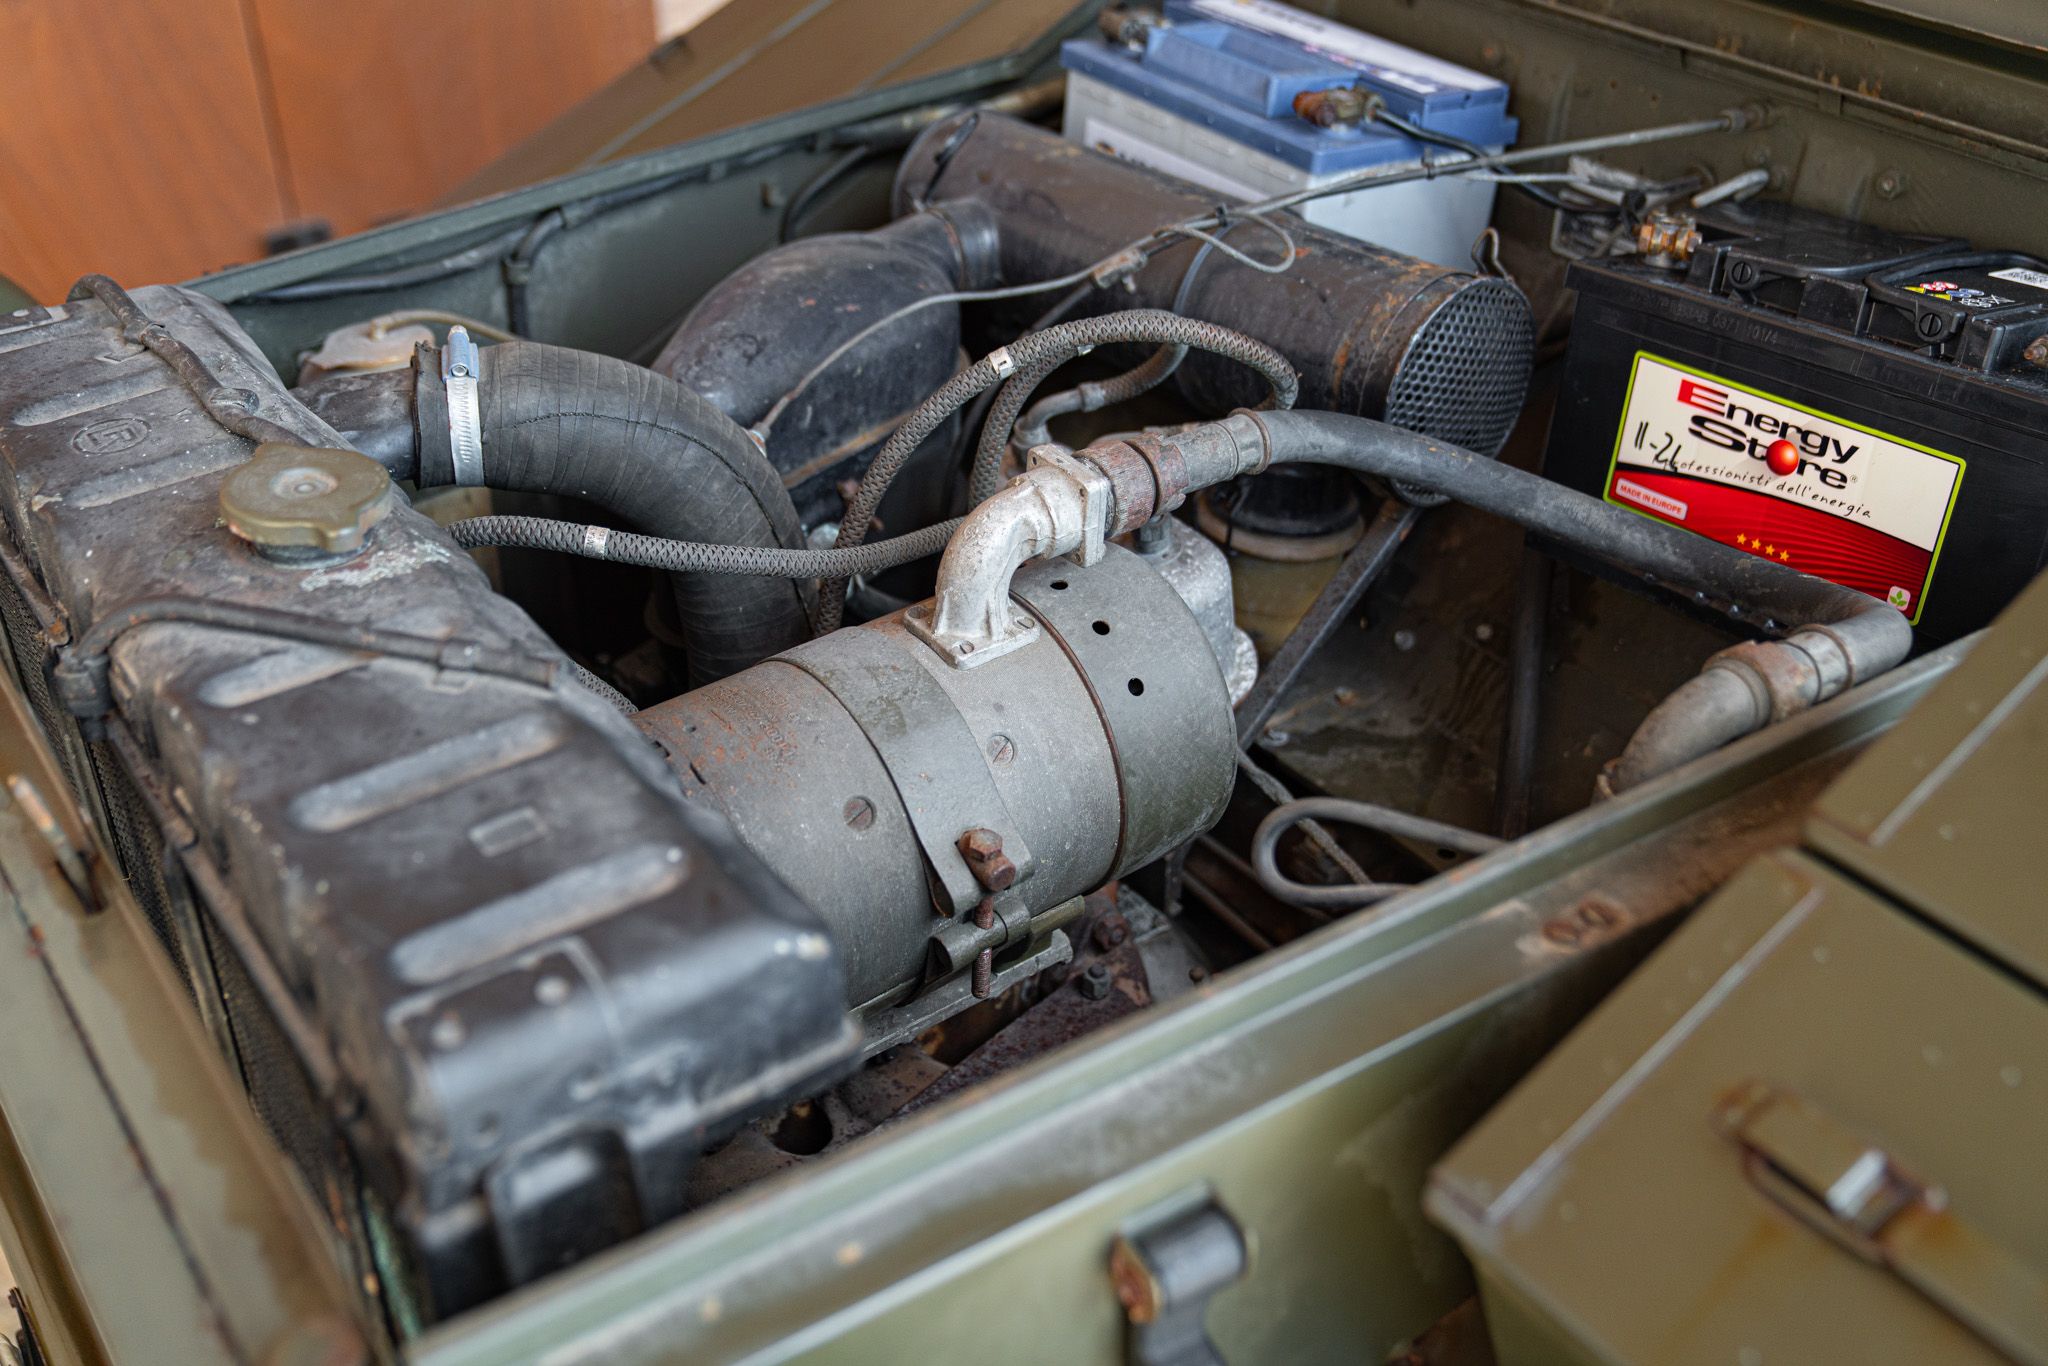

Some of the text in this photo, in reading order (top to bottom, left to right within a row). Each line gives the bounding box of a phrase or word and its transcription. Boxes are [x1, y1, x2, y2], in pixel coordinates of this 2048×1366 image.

[1677, 379, 1860, 464] Energy
[1620, 485, 1642, 498] MADE
[1651, 496, 1683, 514] EUROPE
[1776, 480, 1871, 517] dell'energia
